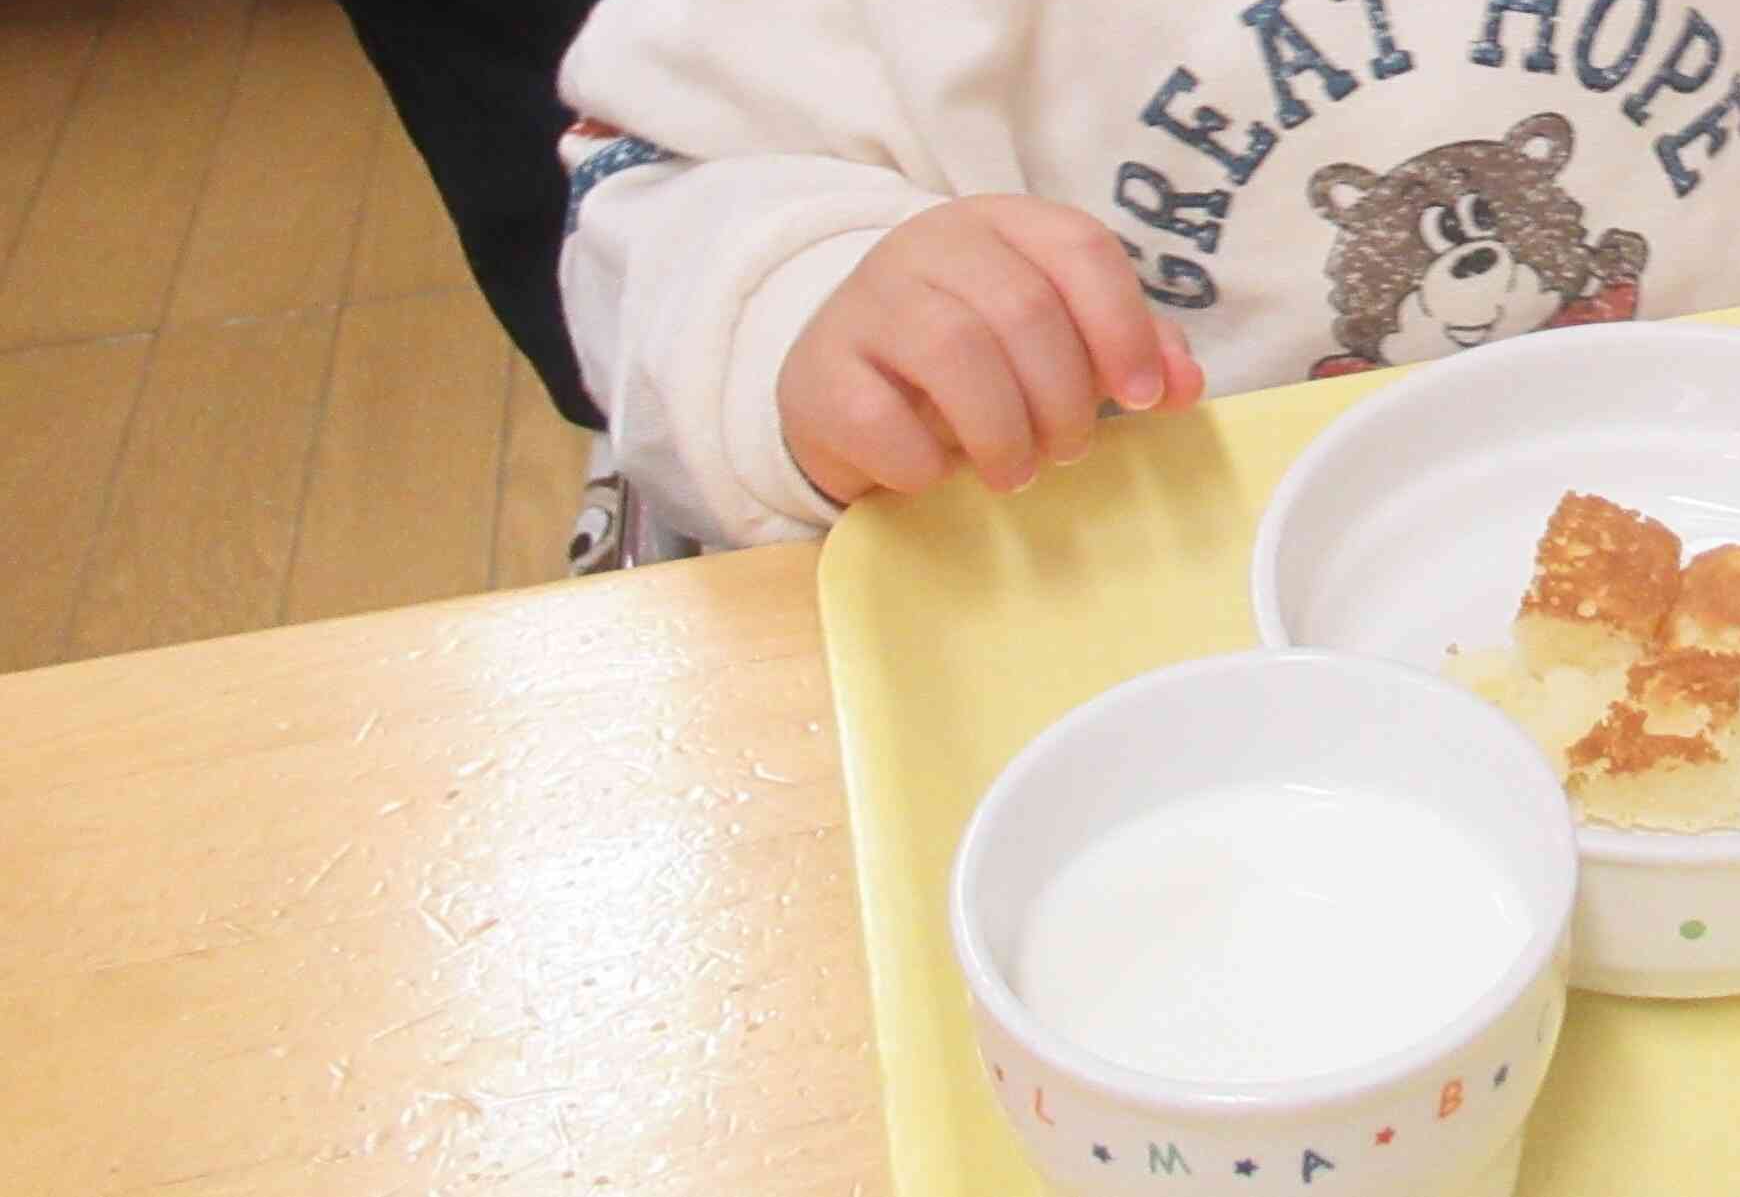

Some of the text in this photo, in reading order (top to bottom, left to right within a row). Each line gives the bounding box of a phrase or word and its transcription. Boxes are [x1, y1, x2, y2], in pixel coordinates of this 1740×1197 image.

[1148, 1141, 1192, 1176] M
[1302, 1148, 1335, 1184] A
[1436, 1077, 1465, 1119] B
